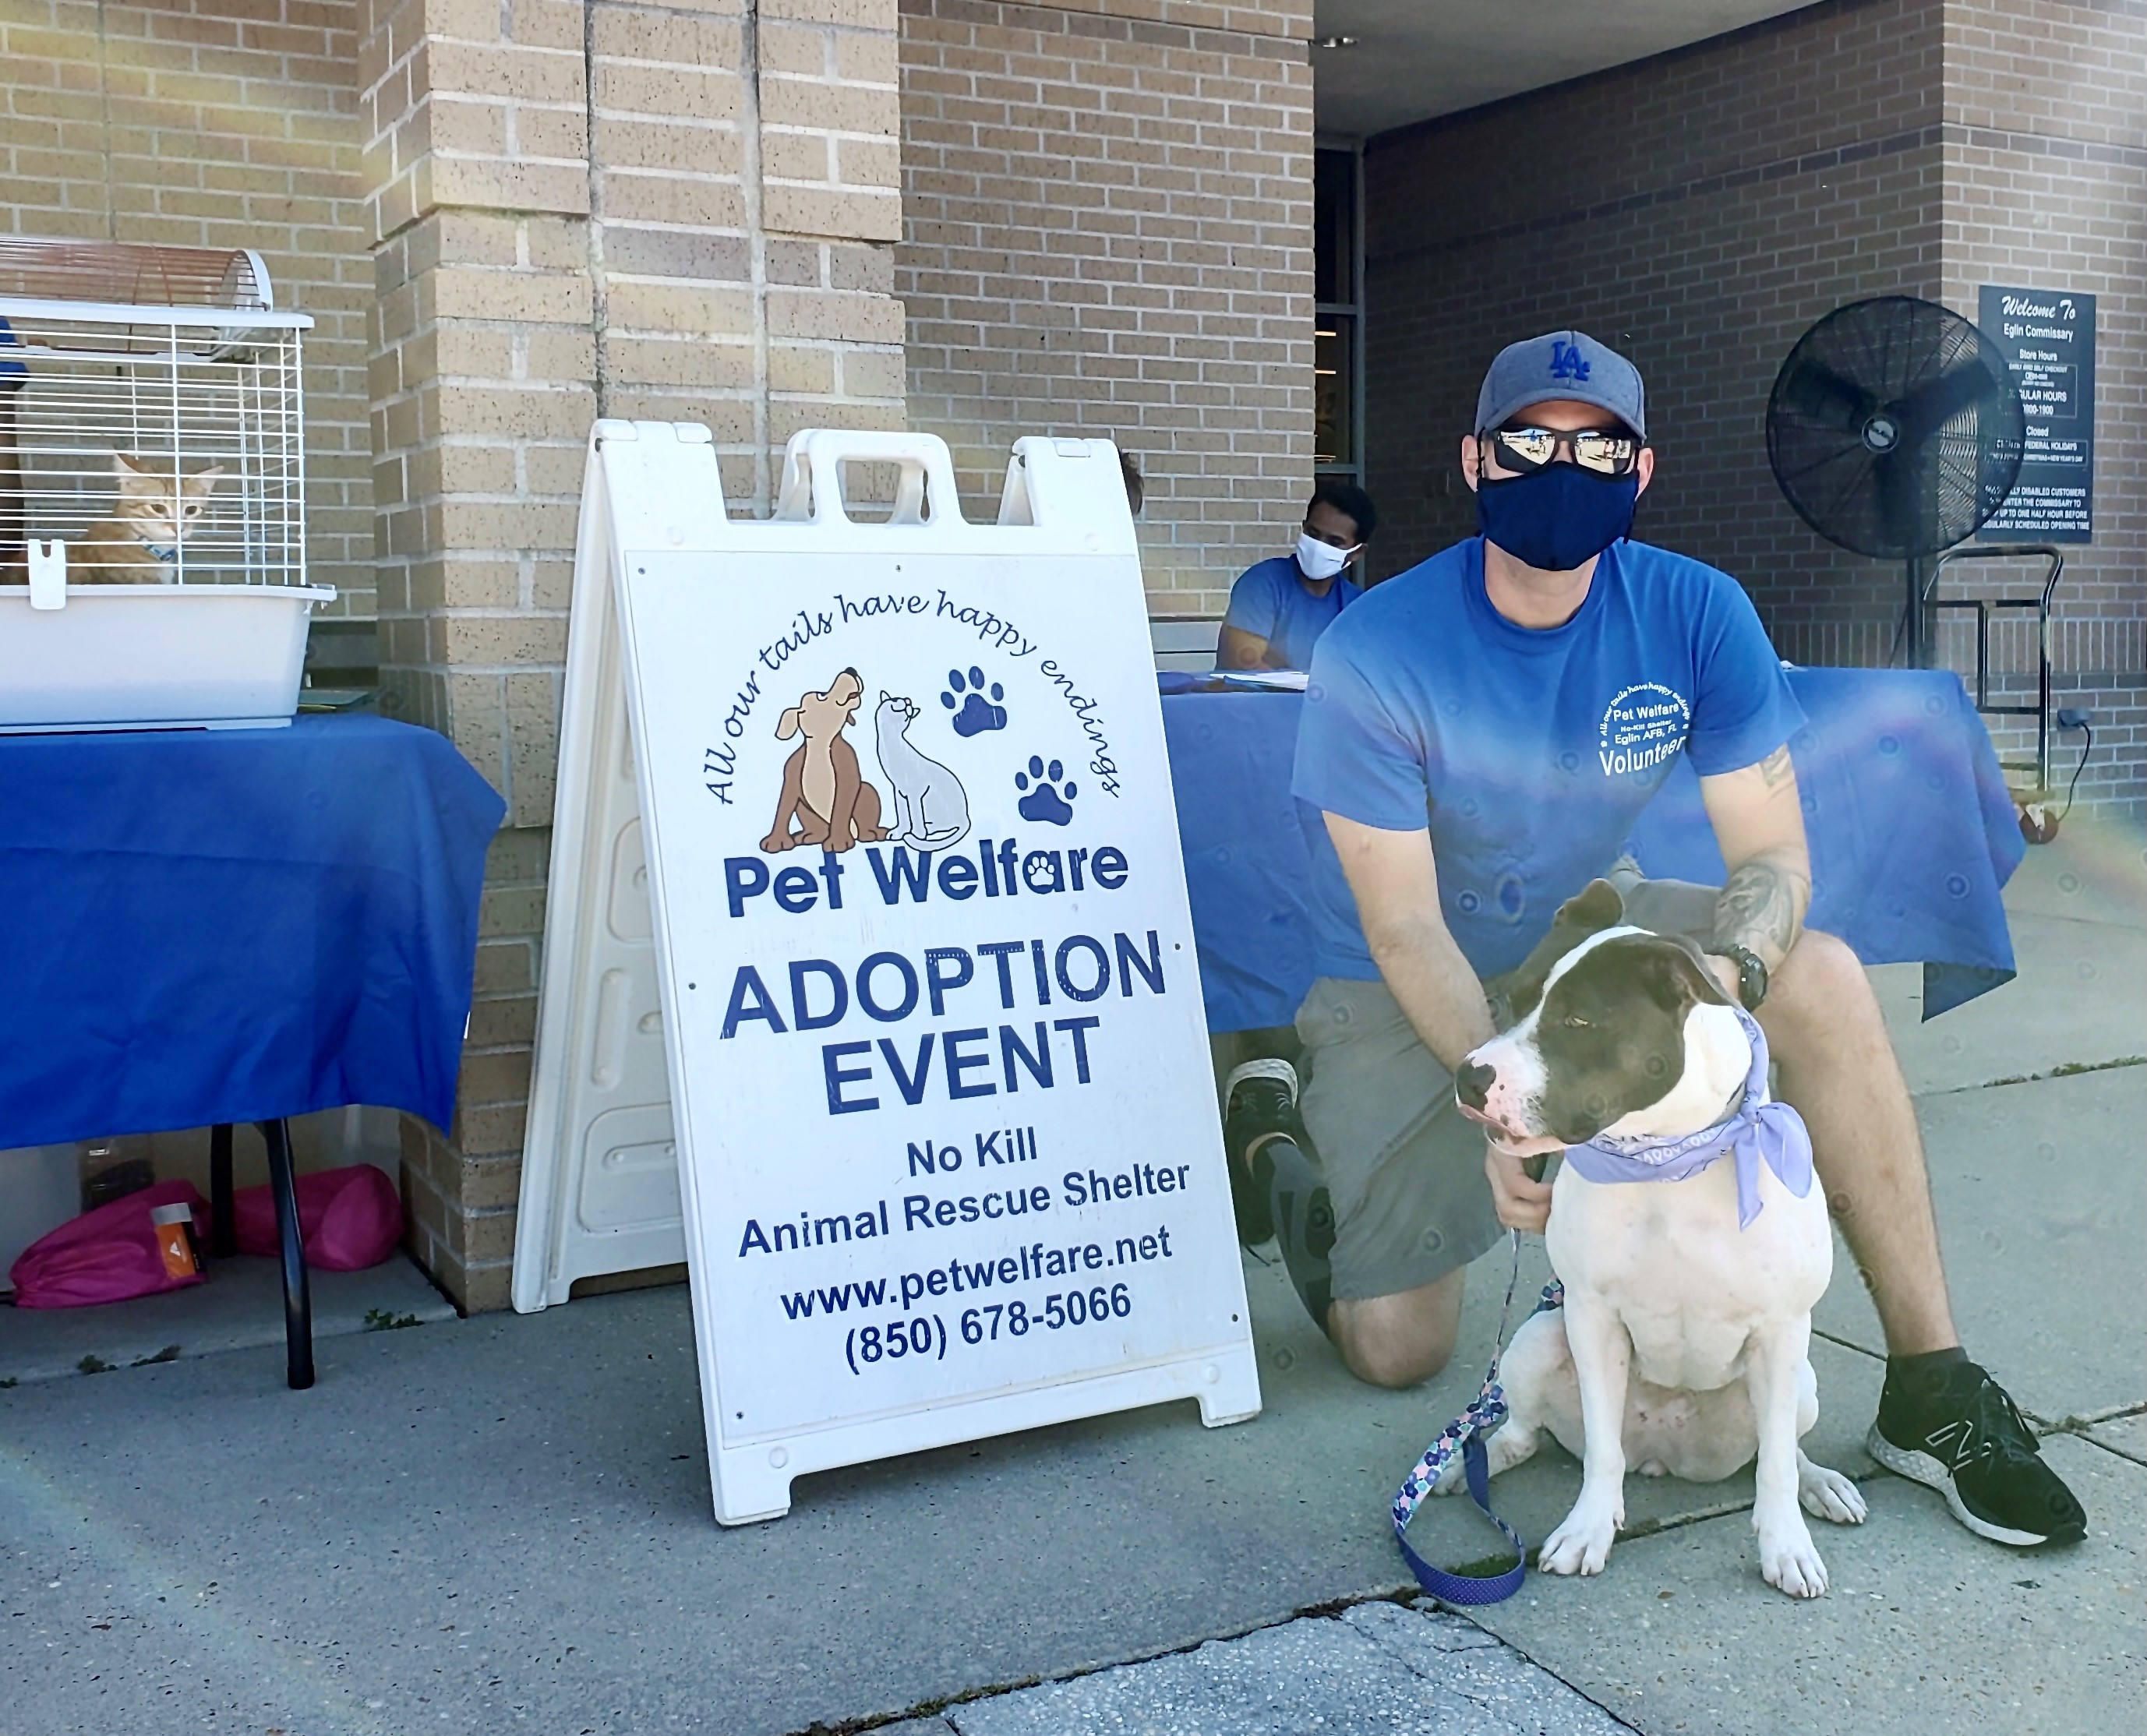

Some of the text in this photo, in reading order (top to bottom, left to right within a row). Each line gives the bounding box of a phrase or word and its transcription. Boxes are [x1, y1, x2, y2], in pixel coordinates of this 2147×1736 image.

[2001, 295, 2076, 320] Welcome To
[2004, 323, 2074, 343] Eglin Commissary
[1549, 340, 1591, 382] LA
[2019, 348, 2058, 361] Store Hours
[2043, 390, 2068, 402] HOURS
[2025, 425, 2050, 437] Closed
[2024, 440, 2050, 450] FEDERAL
[2050, 441, 2078, 451] HOLIDAYS
[2021, 486, 2050, 496] DISABLED
[2050, 487, 2086, 497] CUSTOMERS
[2035, 498, 2073, 507] COMMISSARY
[2073, 499, 2082, 507] TO
[1999, 508, 2008, 517] UP
[2008, 509, 2017, 517] TO
[2030, 509, 2046, 518] HALF
[2046, 510, 2064, 519] HOUR
[2064, 510, 2088, 519] BEFORE
[2015, 520, 2050, 529] SCHEDULED
[2050, 520, 2076, 530] OPENING
[2076, 521, 2090, 530] TIME
[704, 589, 1121, 805] All our tails have happy endings
[1626, 683, 1648, 693] have
[1648, 681, 1673, 696] happy
[1612, 703, 1679, 722] Pet Welfare
[1647, 719, 1672, 729] Shelter
[1615, 724, 1677, 746] Eglin AFB, FL
[1598, 736, 1686, 776] Volunteer
[723, 837, 1129, 918] Pet Welfare
[719, 930, 1167, 1040] ADOPTION
[821, 1015, 1100, 1116] EVENT
[906, 1126, 1039, 1177] No Kill
[737, 1162, 1191, 1258] Animal Rescue Shelter
[779, 1224, 1174, 1321] www.petwelfare.net
[844, 1282, 1132, 1376] (850) 678-5066
